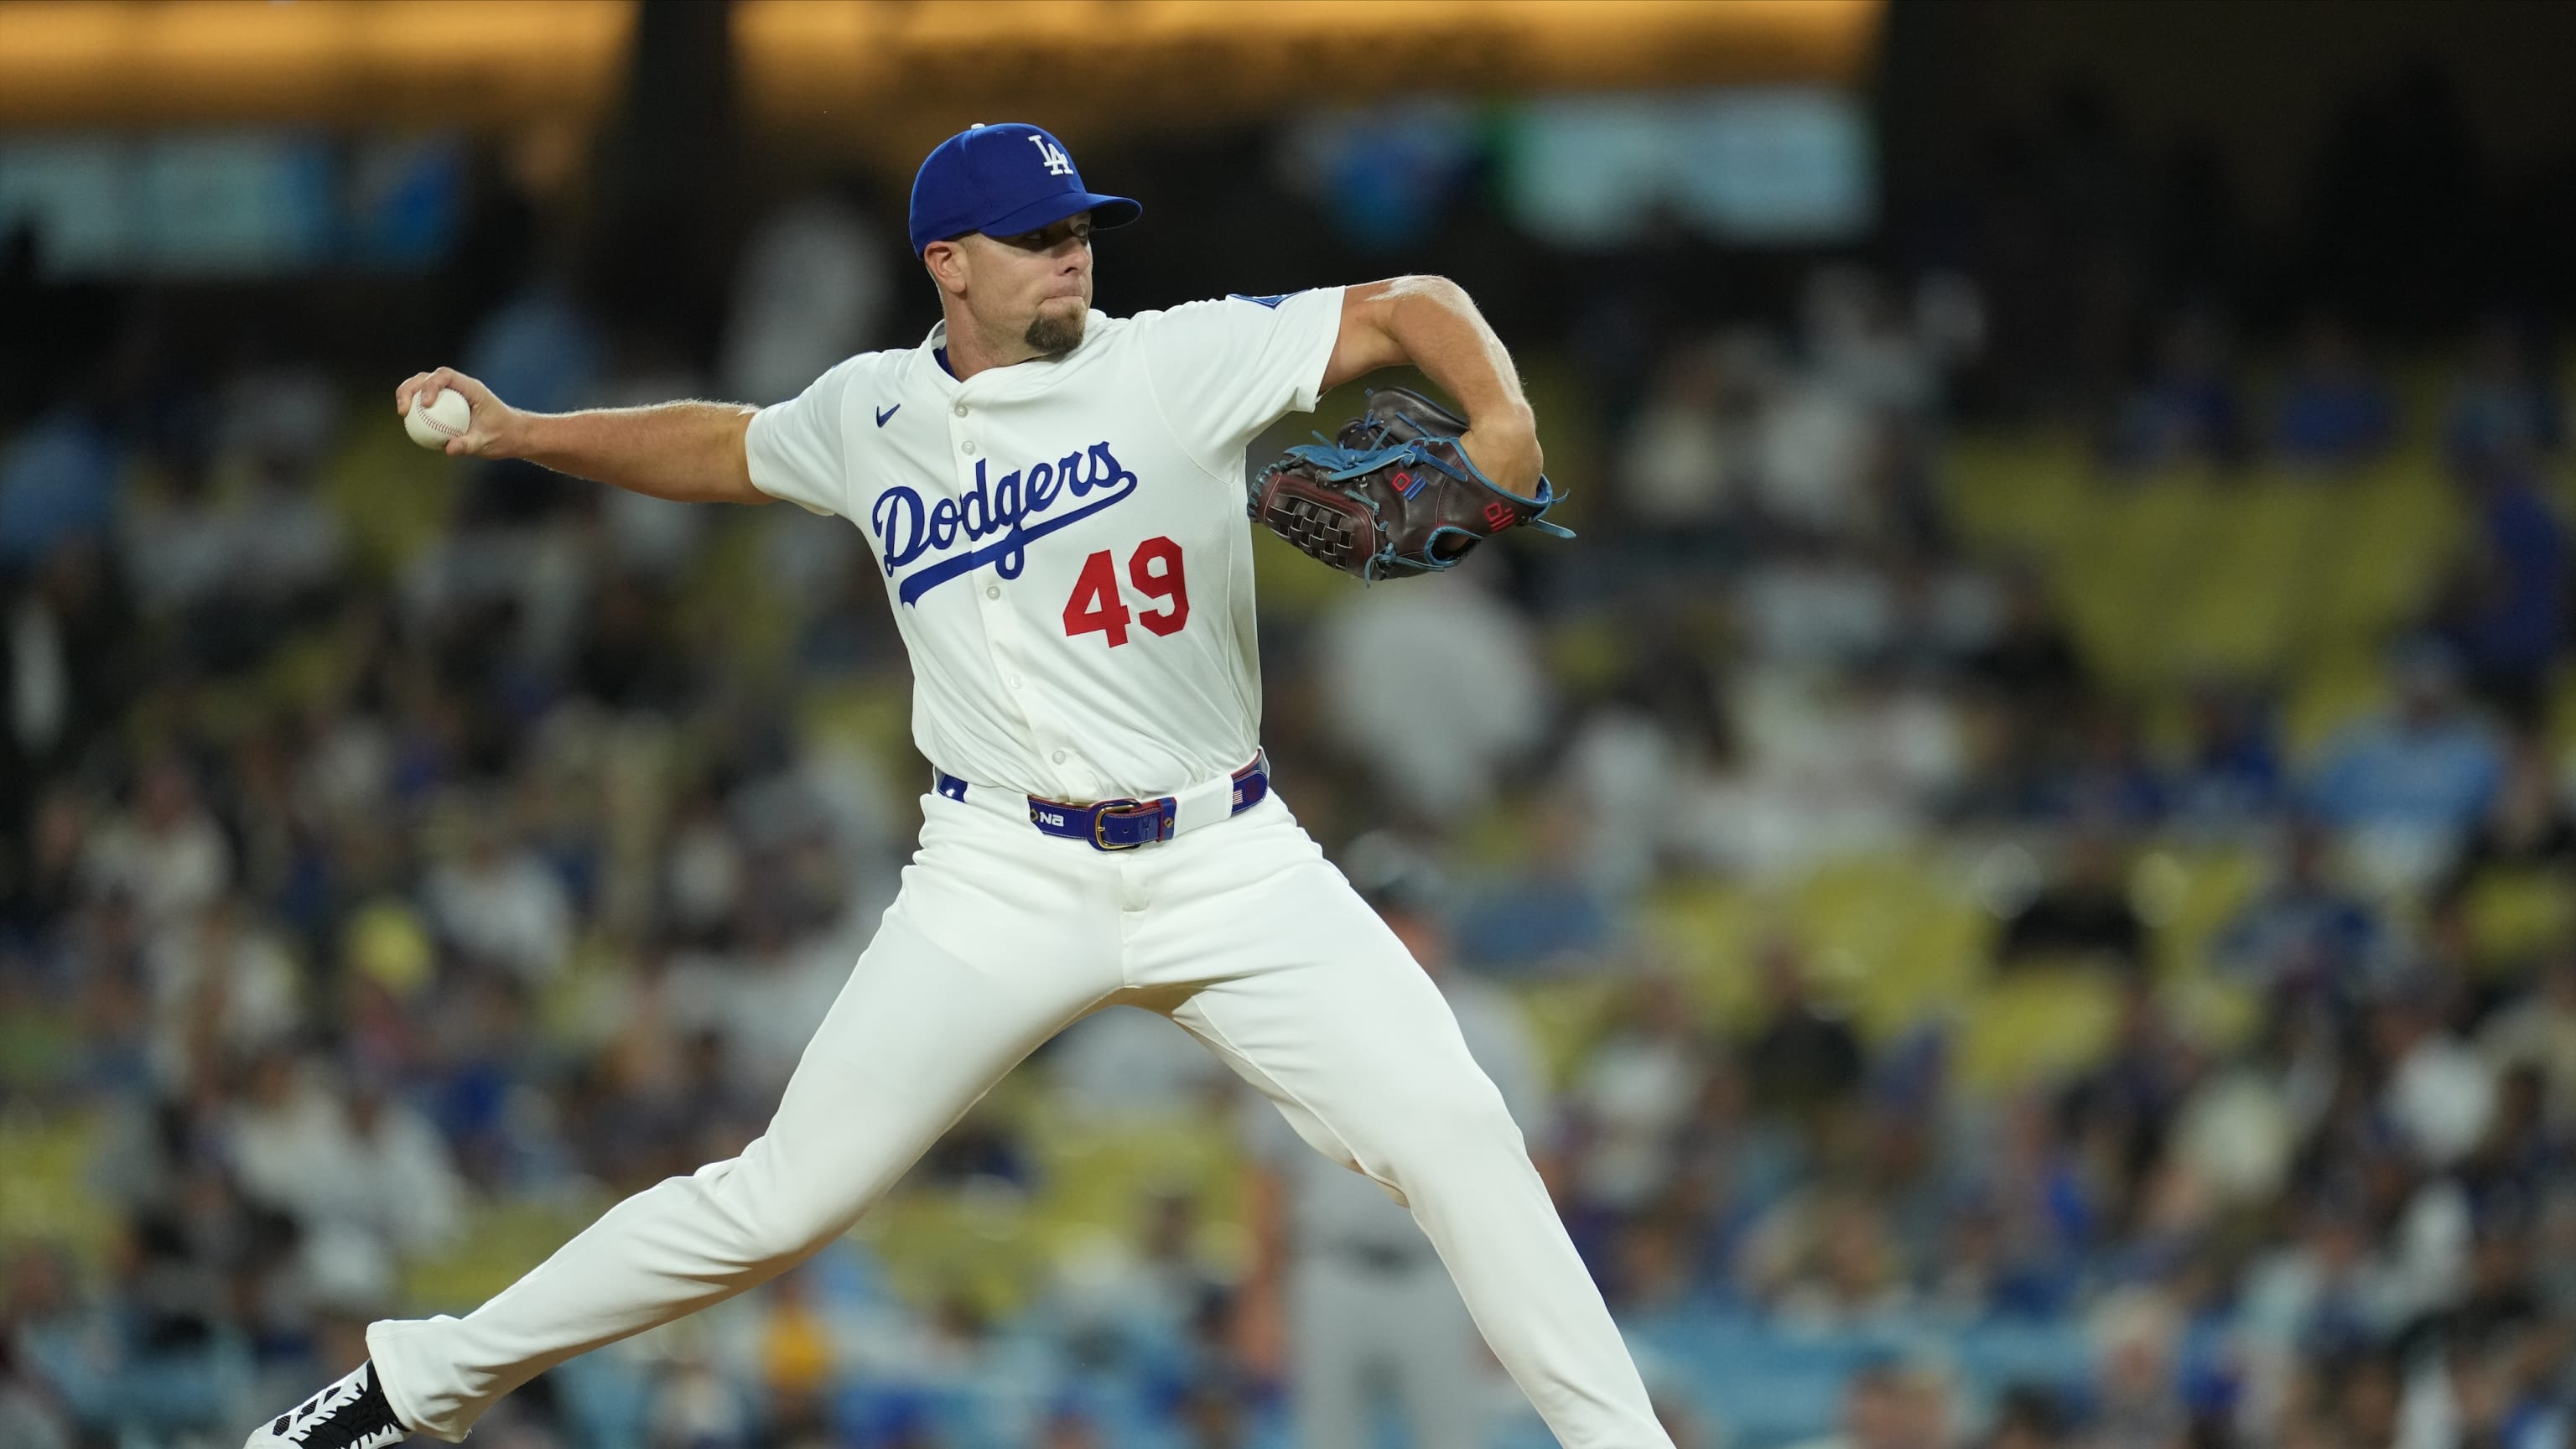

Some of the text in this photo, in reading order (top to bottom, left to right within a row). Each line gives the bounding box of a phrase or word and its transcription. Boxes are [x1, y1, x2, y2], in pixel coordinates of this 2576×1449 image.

[1027, 134, 1074, 176] LA
[872, 441, 1137, 581] Dodgers
[1062, 535, 1190, 648] 49
